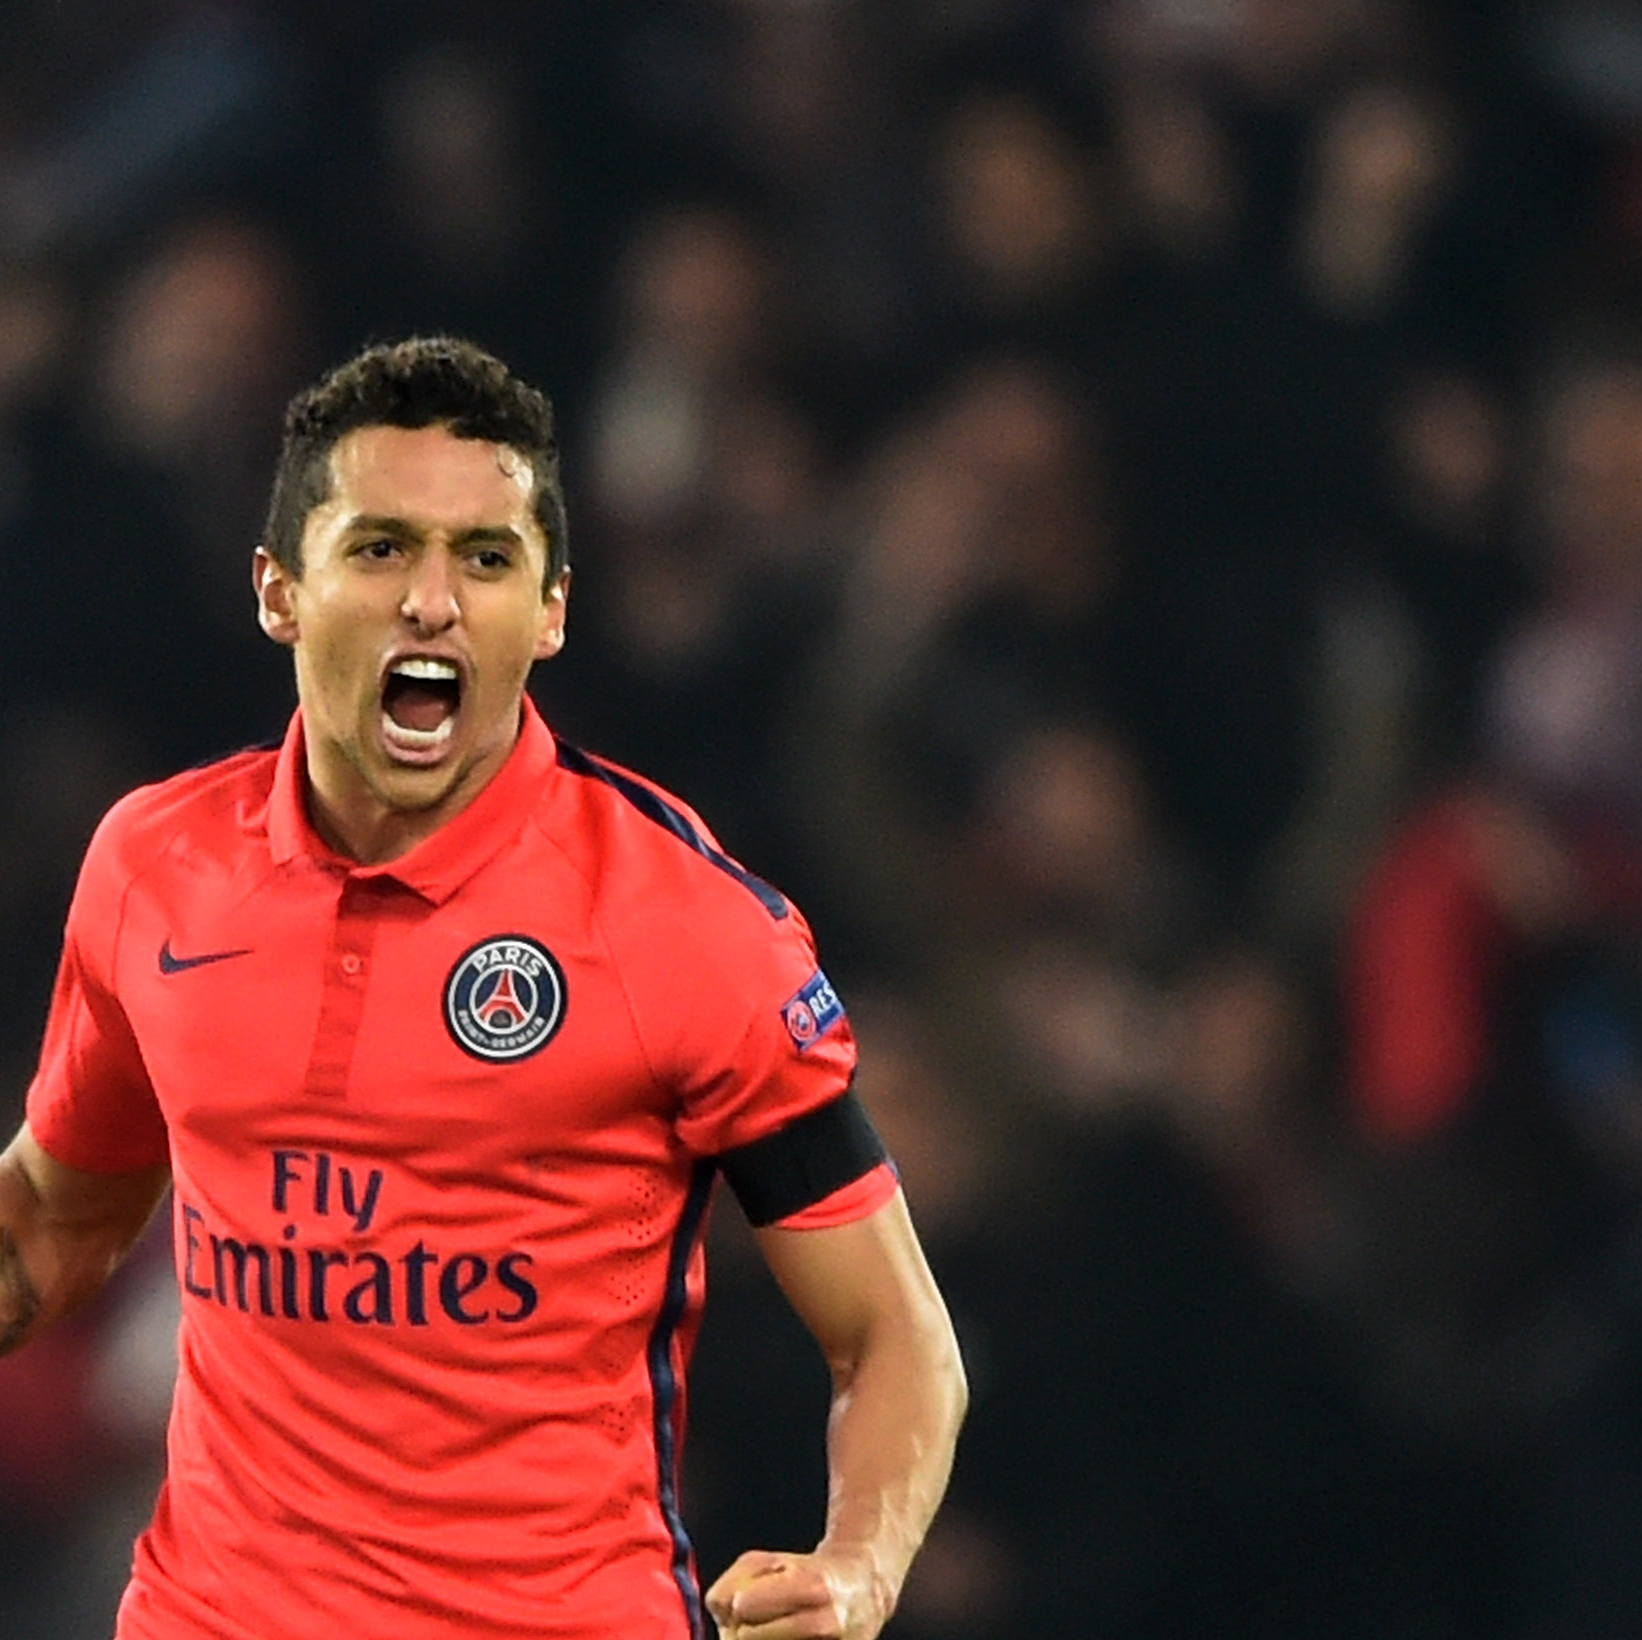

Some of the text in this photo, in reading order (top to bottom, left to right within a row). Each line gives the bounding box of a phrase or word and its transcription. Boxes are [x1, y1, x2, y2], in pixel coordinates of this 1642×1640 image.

[472, 946, 544, 978] PARIS
[271, 1148, 383, 1233] Fly
[182, 1202, 539, 1328] Emirates
